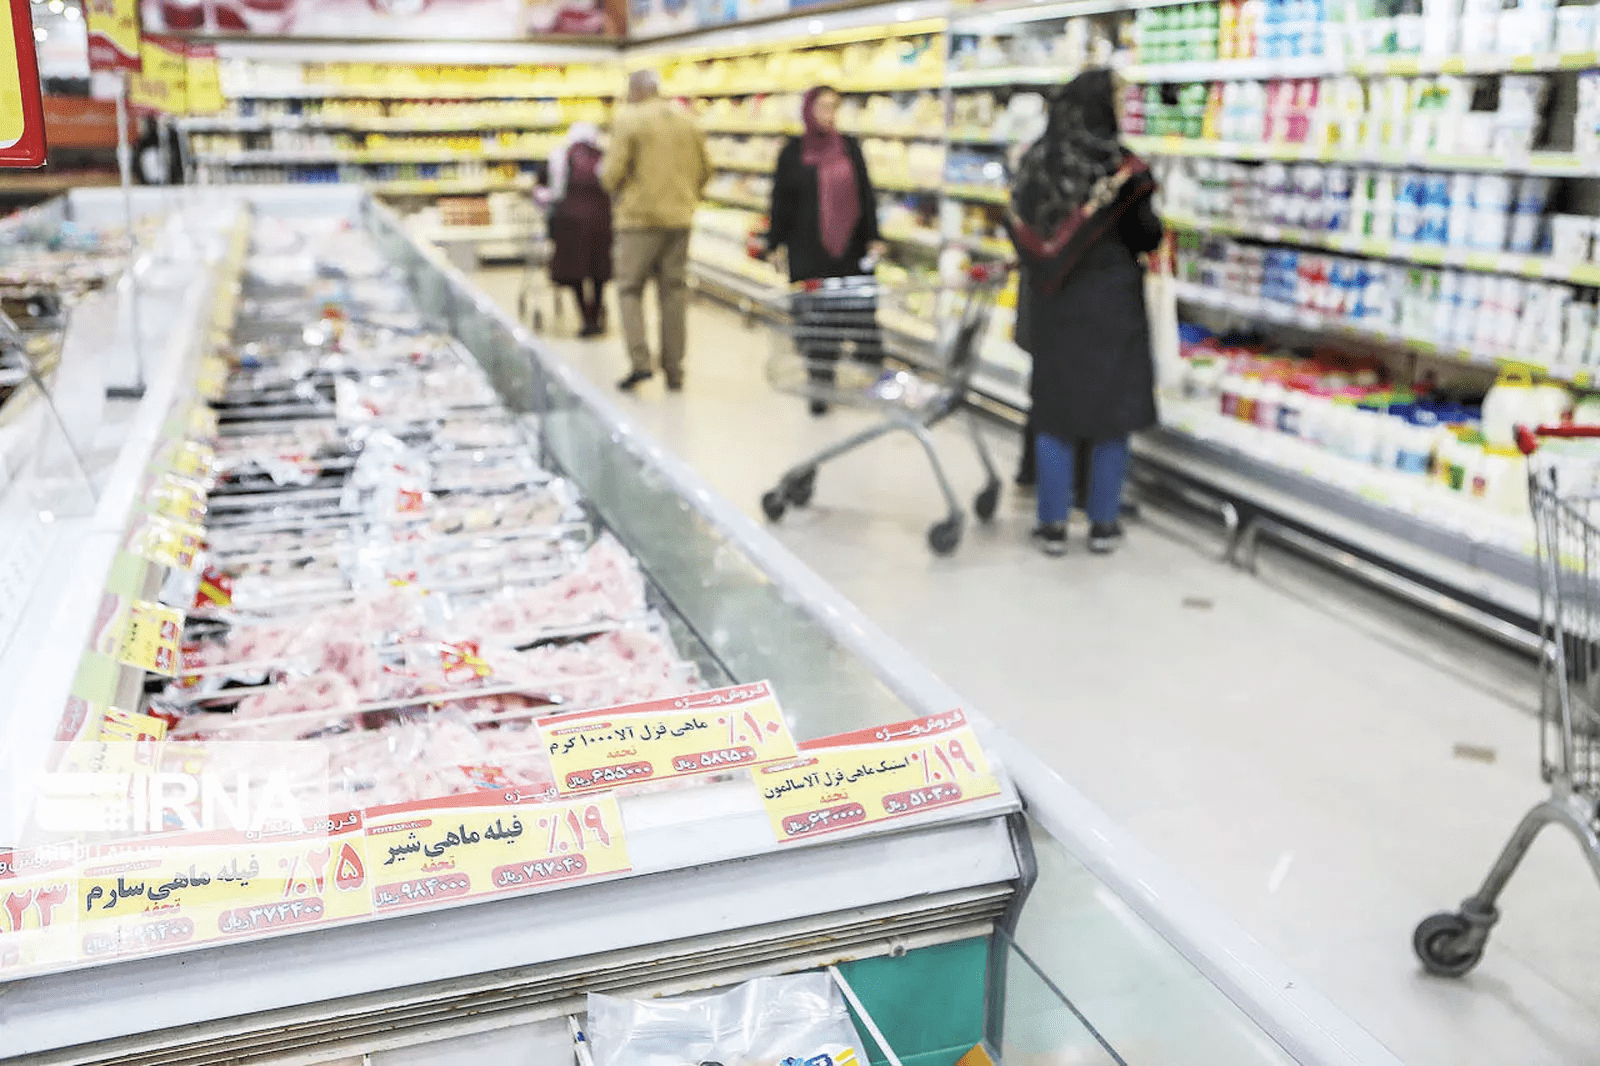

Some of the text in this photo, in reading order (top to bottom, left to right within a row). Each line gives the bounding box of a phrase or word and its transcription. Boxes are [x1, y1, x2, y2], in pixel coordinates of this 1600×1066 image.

[674, 694, 723, 710] ویژه
[640, 722, 667, 741] قزل
[671, 718, 708, 737] ماهی
[875, 724, 921, 742] ویژه
[592, 767, 650, 782] ۶۵۵۰۰۰
[846, 764, 876, 783] ماهی
[383, 815, 524, 866] فیله ماهی شیر
[86, 854, 259, 912] فیله ماهی سارم
